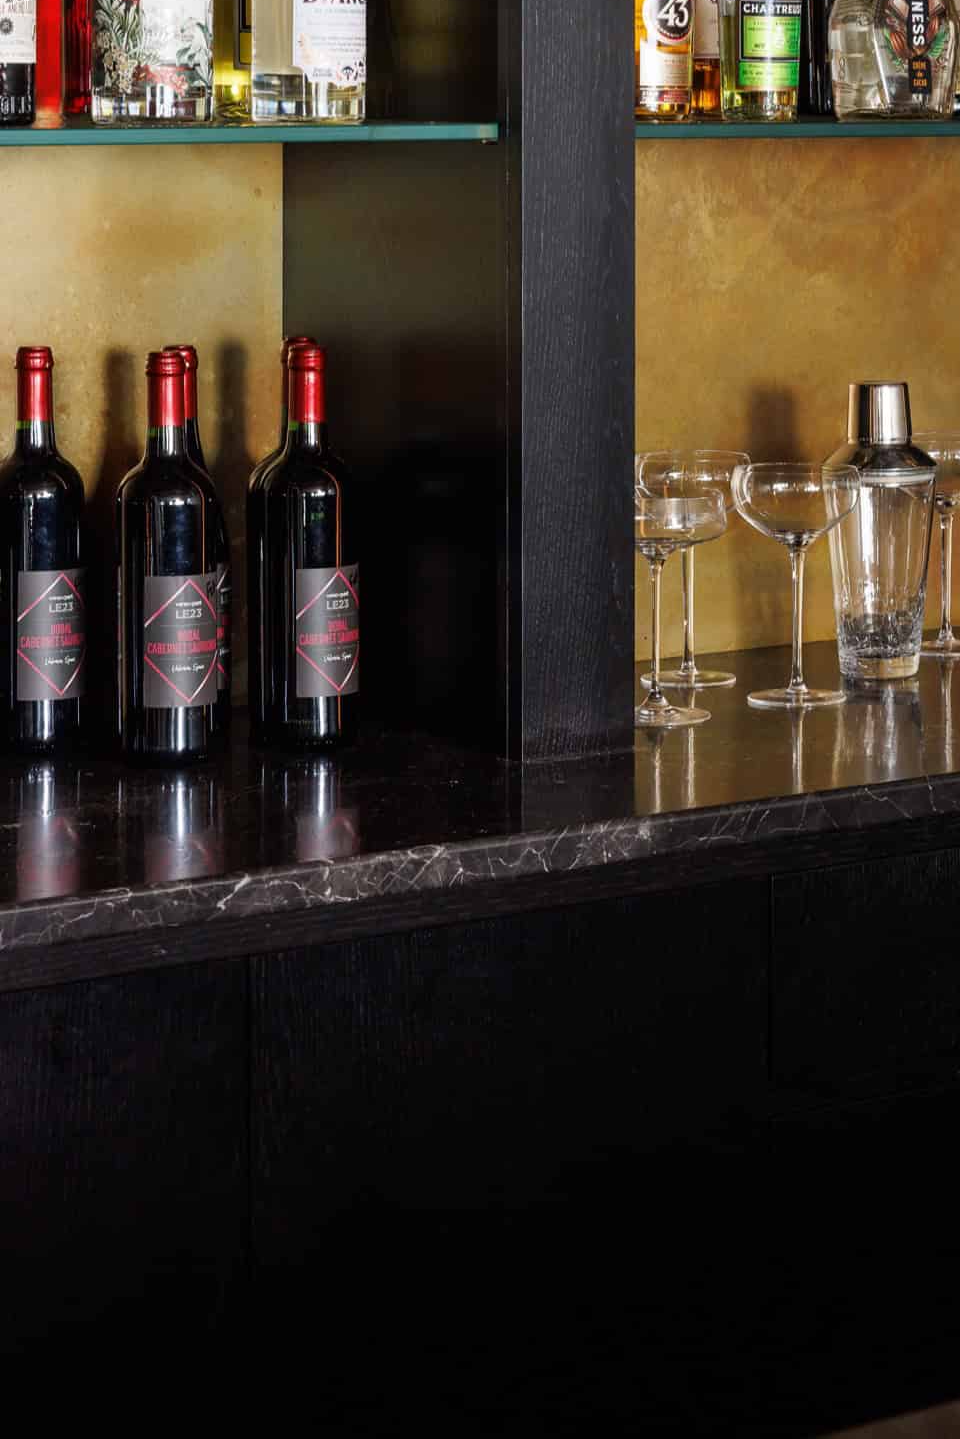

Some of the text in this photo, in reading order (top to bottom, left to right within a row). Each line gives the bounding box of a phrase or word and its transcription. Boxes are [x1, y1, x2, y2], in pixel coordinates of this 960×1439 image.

[49, 603, 73, 613] LE23
[326, 600, 350, 610] LE23
[176, 609, 202, 619] LE23
